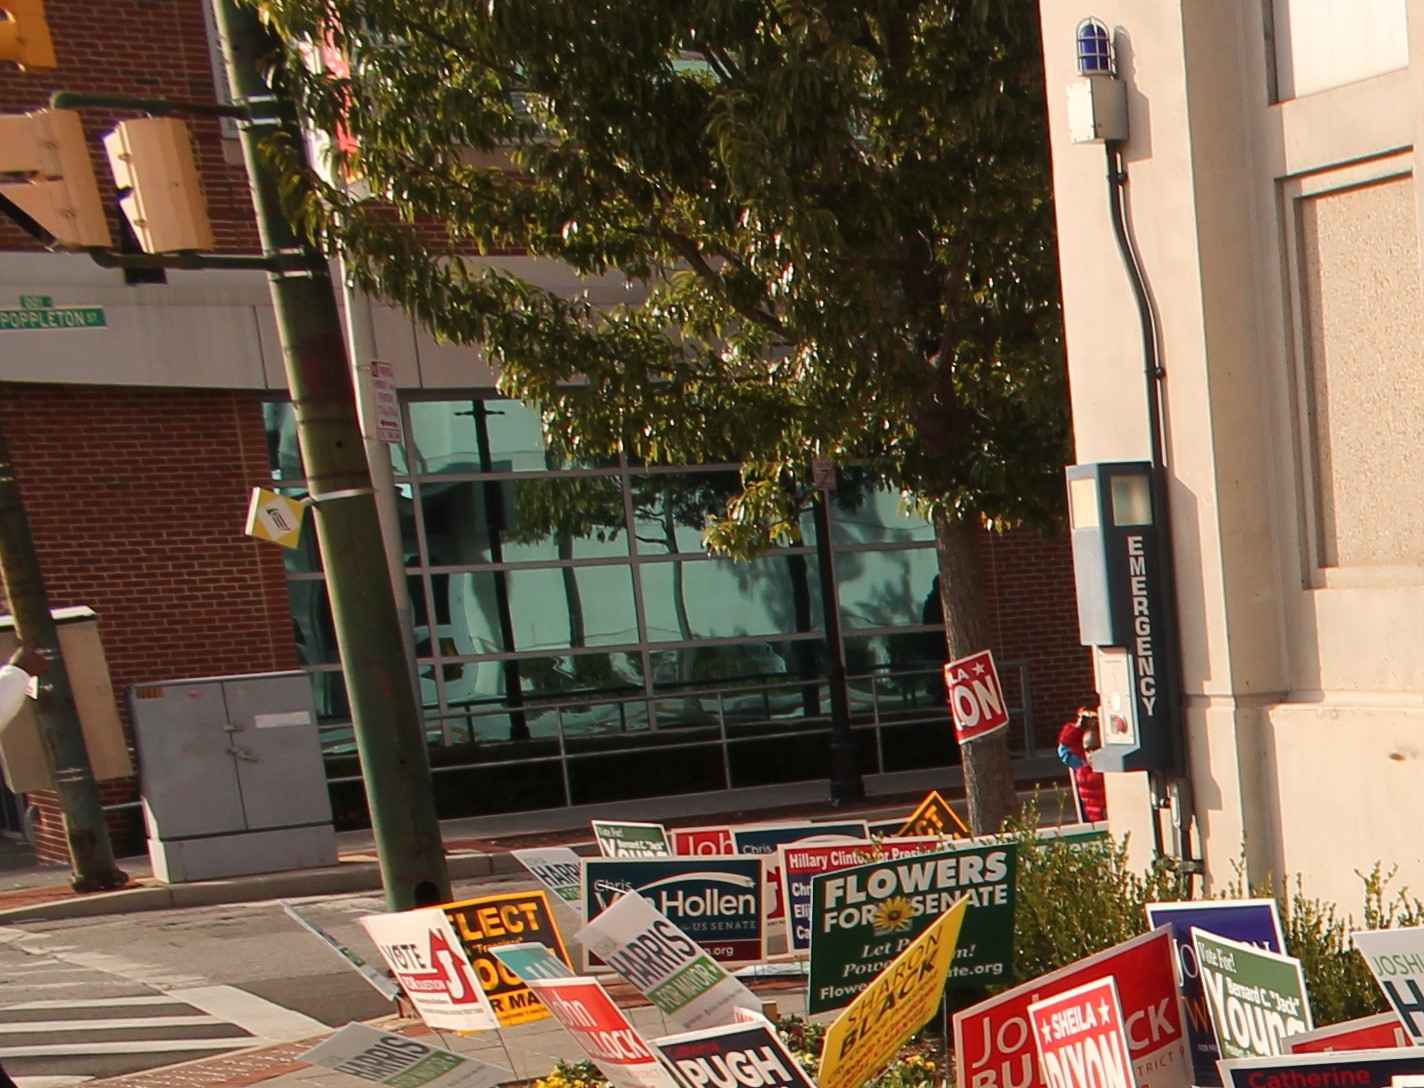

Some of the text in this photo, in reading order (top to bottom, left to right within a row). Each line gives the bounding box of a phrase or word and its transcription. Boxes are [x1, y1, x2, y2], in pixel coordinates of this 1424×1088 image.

[0, 311, 86, 328] POPPLETON
[1127, 535, 1156, 717] EMERGENCY
[789, 853, 828, 871] Hillary
[831, 849, 869, 867] Clinto
[594, 879, 632, 893] Chris
[824, 851, 1008, 909] FLOWERS
[661, 888, 756, 918] Hollen
[823, 884, 1008, 934] FOR SENATE
[692, 923, 708, 932] US
[711, 920, 757, 931] SENATE
[380, 943, 427, 970] VOTE
[606, 919, 697, 993] HARRIS
[862, 944, 891, 959] Let
[660, 989, 682, 1011] FOR
[680, 963, 712, 996] MAYOR
[820, 982, 869, 1000] Flowe
[845, 924, 944, 1034] SHARON
[837, 946, 938, 1061] BLACK
[1051, 1001, 1098, 1040] SHEILA
[334, 1035, 431, 1083] HARRIS
